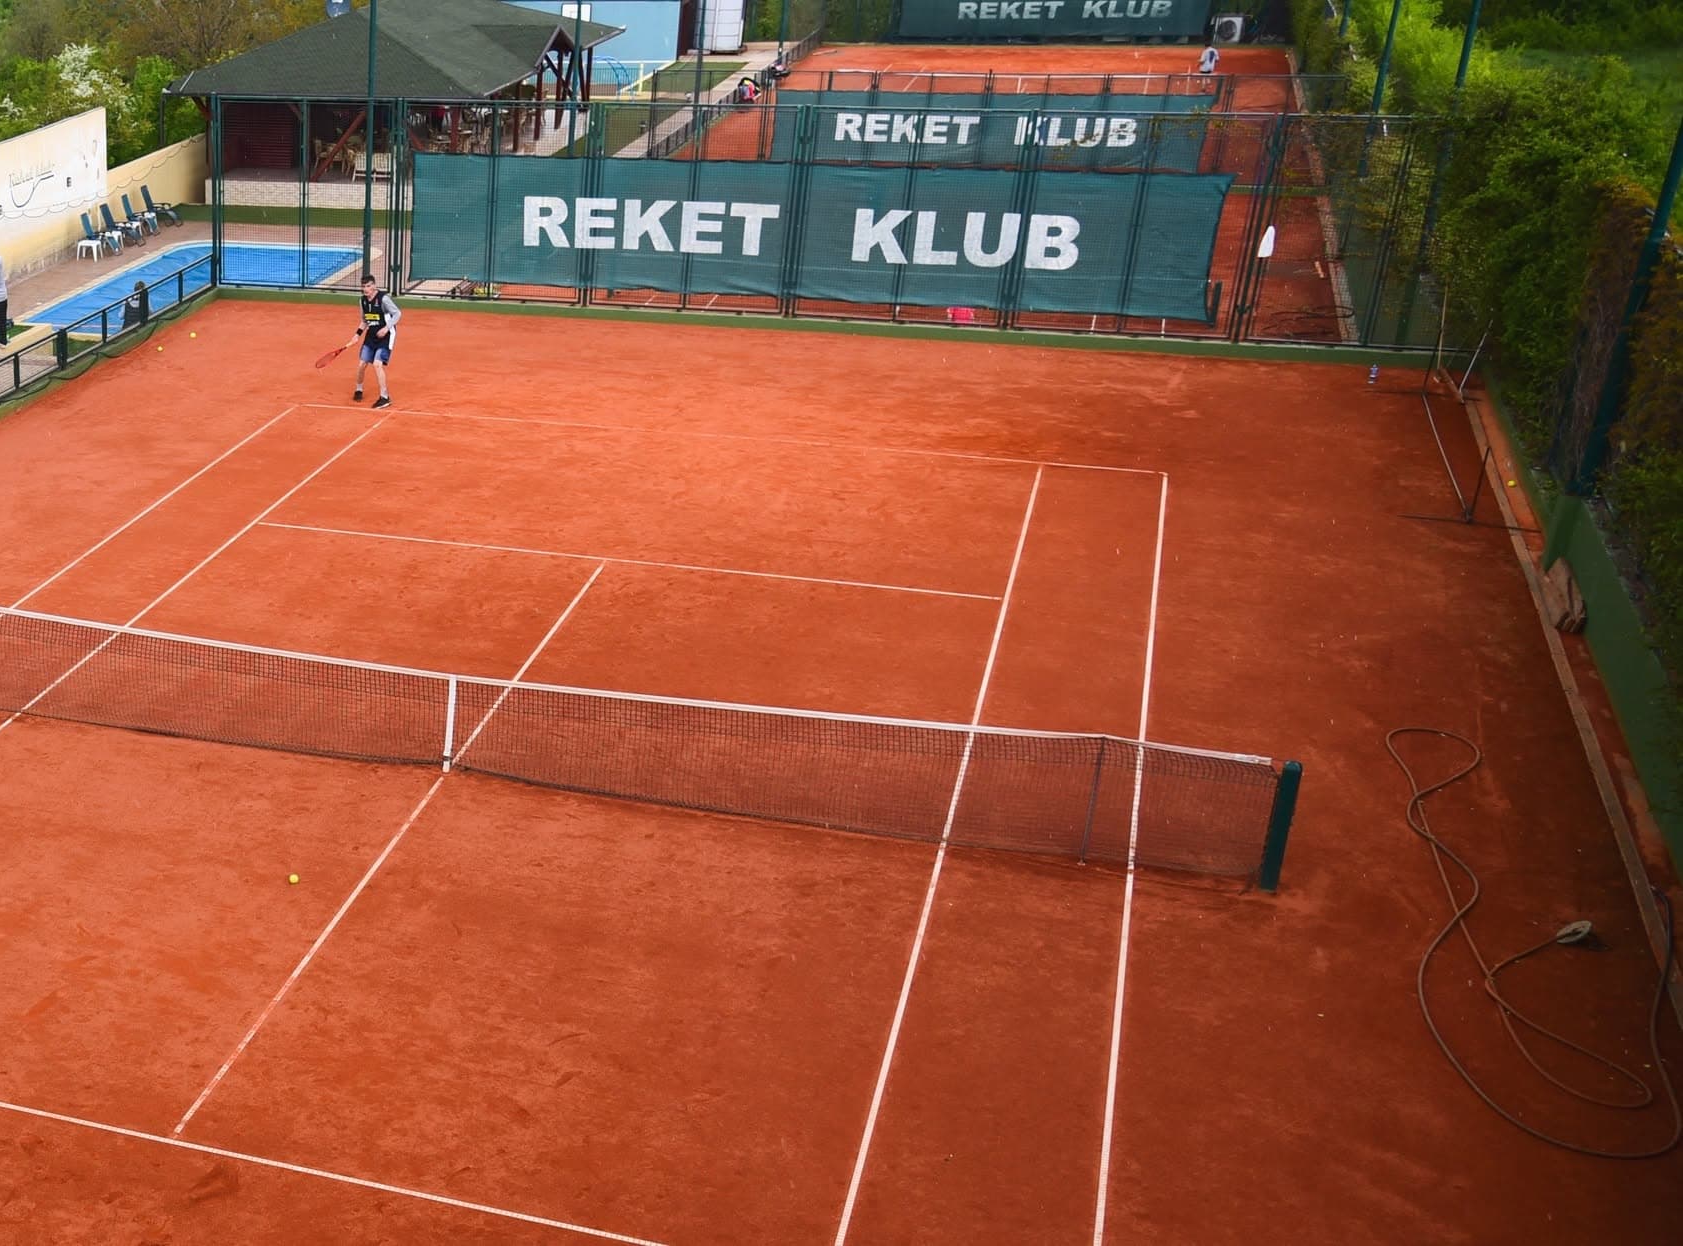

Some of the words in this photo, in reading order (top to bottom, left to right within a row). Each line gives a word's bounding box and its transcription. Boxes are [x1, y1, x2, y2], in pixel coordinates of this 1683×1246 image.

[957, 1, 1065, 20] REKET
[1081, 0, 1172, 19] KLUB
[833, 112, 981, 145] REKET
[523, 195, 781, 257] REKET
[850, 207, 1081, 271] KLUB
